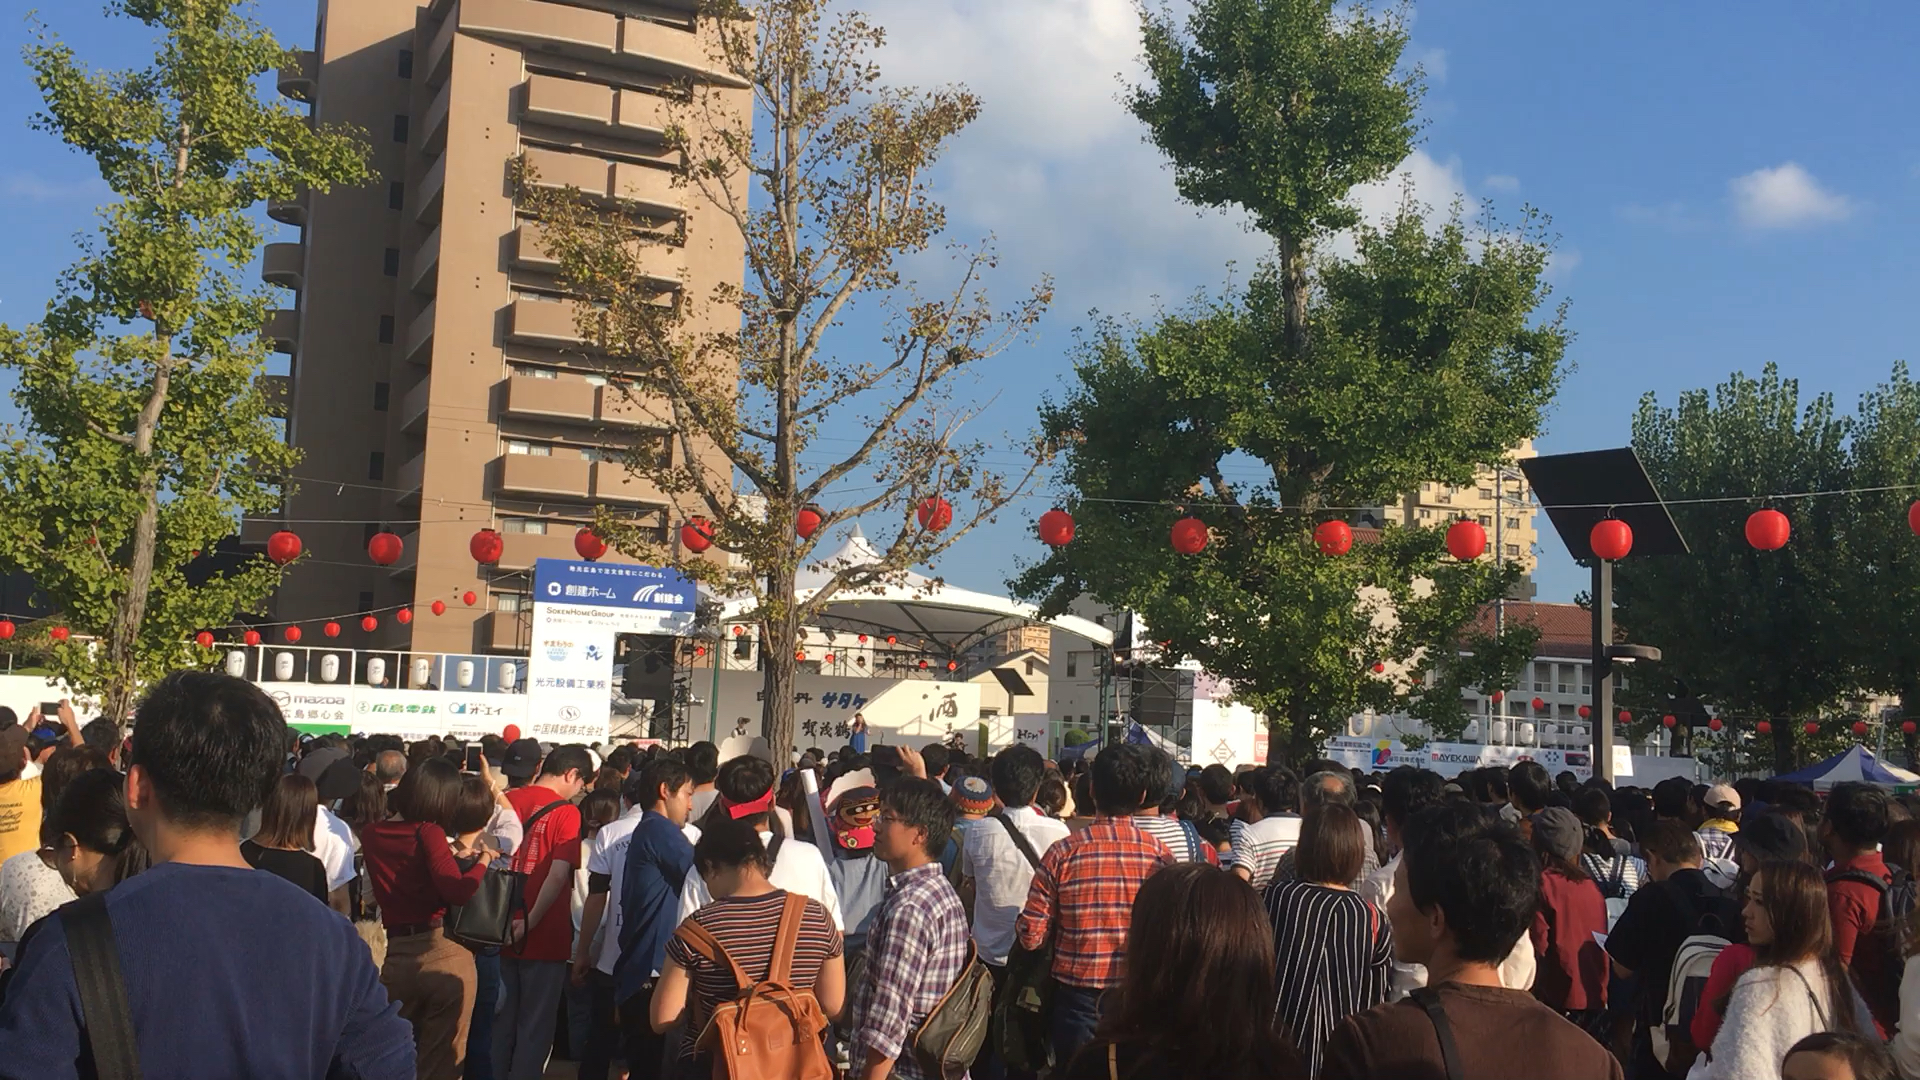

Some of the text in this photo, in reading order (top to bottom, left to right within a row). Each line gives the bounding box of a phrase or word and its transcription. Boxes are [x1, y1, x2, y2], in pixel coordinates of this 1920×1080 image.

[565, 584, 616, 599] 創建ホーム
[822, 691, 868, 710] サタケ
